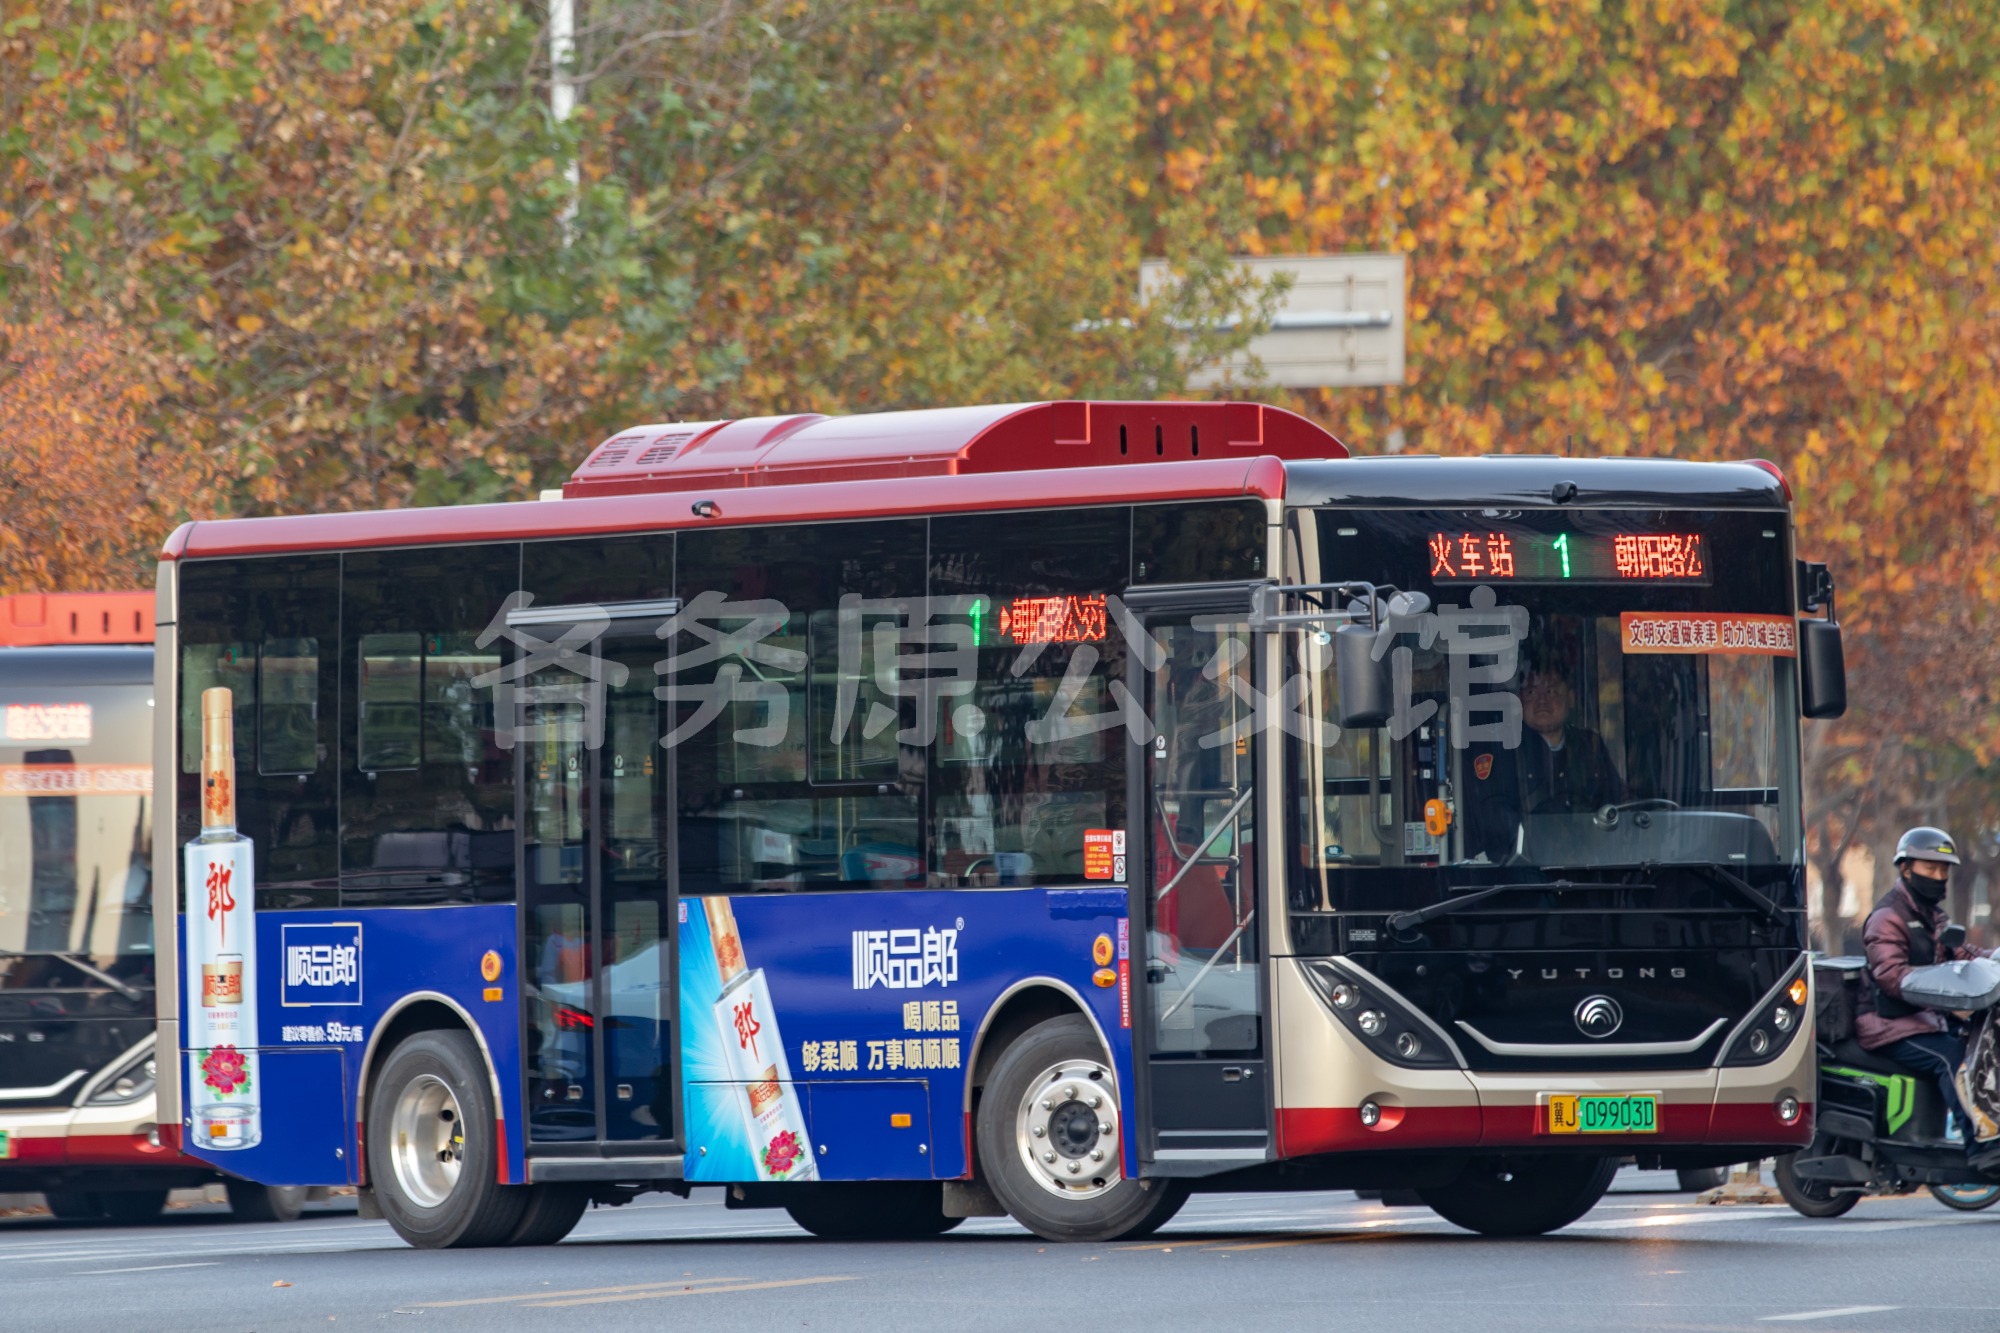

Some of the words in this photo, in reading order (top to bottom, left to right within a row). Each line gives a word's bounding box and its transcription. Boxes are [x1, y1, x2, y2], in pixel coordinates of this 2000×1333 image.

[1429, 533, 1514, 577] 火车站
[1553, 533, 1570, 578] 1
[969, 599, 981, 646] 1
[1629, 619, 1718, 647] 文明交通做表率
[206, 861, 236, 948] 郎
[287, 943, 357, 987] 顺品郎
[852, 925, 959, 990] 顺品郎
[1507, 967, 1686, 979] YUTONG
[734, 1001, 760, 1064] 郎
[903, 1000, 961, 1032] 喝顺品
[802, 1040, 859, 1072] 够柔顺
[866, 1038, 961, 1071] 万事顺顺顺
